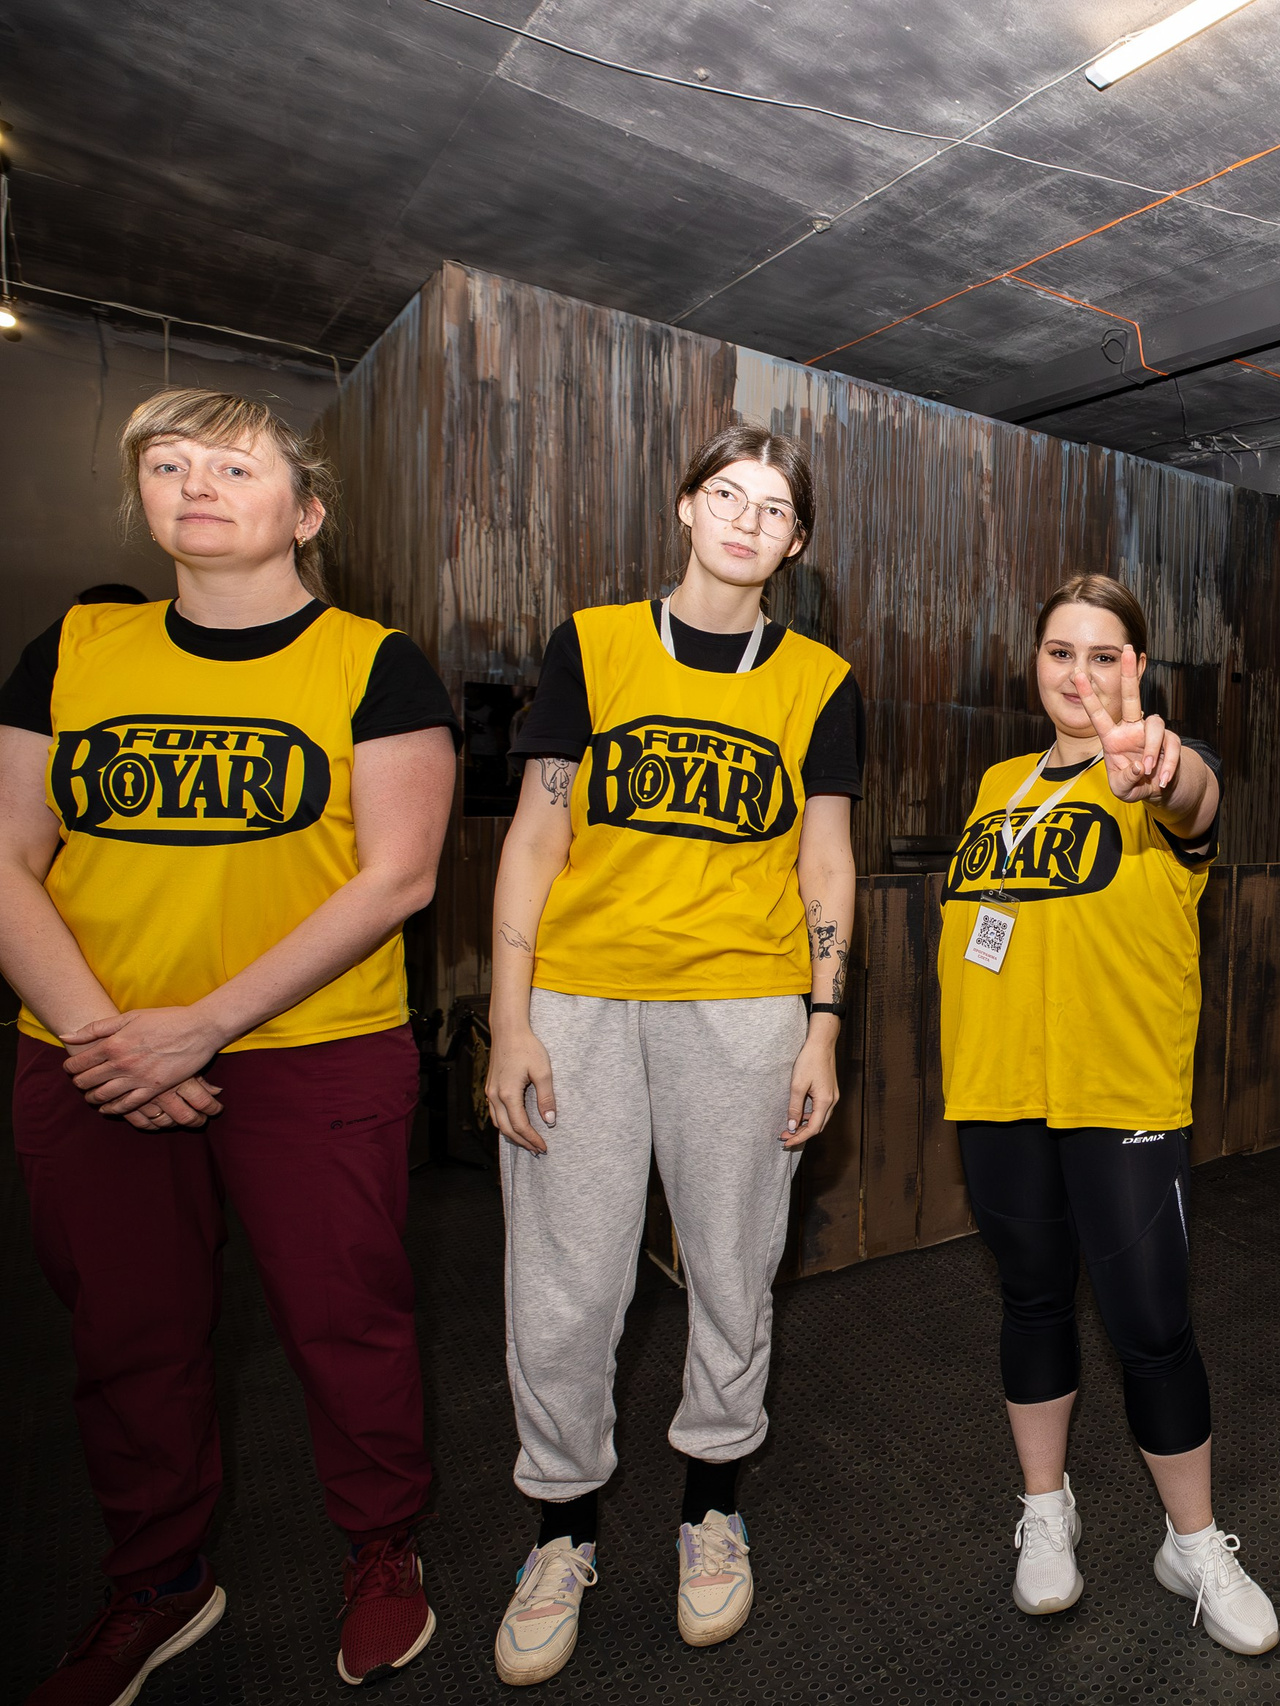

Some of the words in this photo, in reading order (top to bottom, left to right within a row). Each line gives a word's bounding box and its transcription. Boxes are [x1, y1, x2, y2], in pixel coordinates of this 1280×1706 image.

[120, 728, 261, 751] FORT
[643, 729, 752, 764] FORT
[51, 730, 331, 832] BOYARD
[587, 731, 798, 838] BOYARD
[1121, 1132, 1166, 1145] DEMIX
